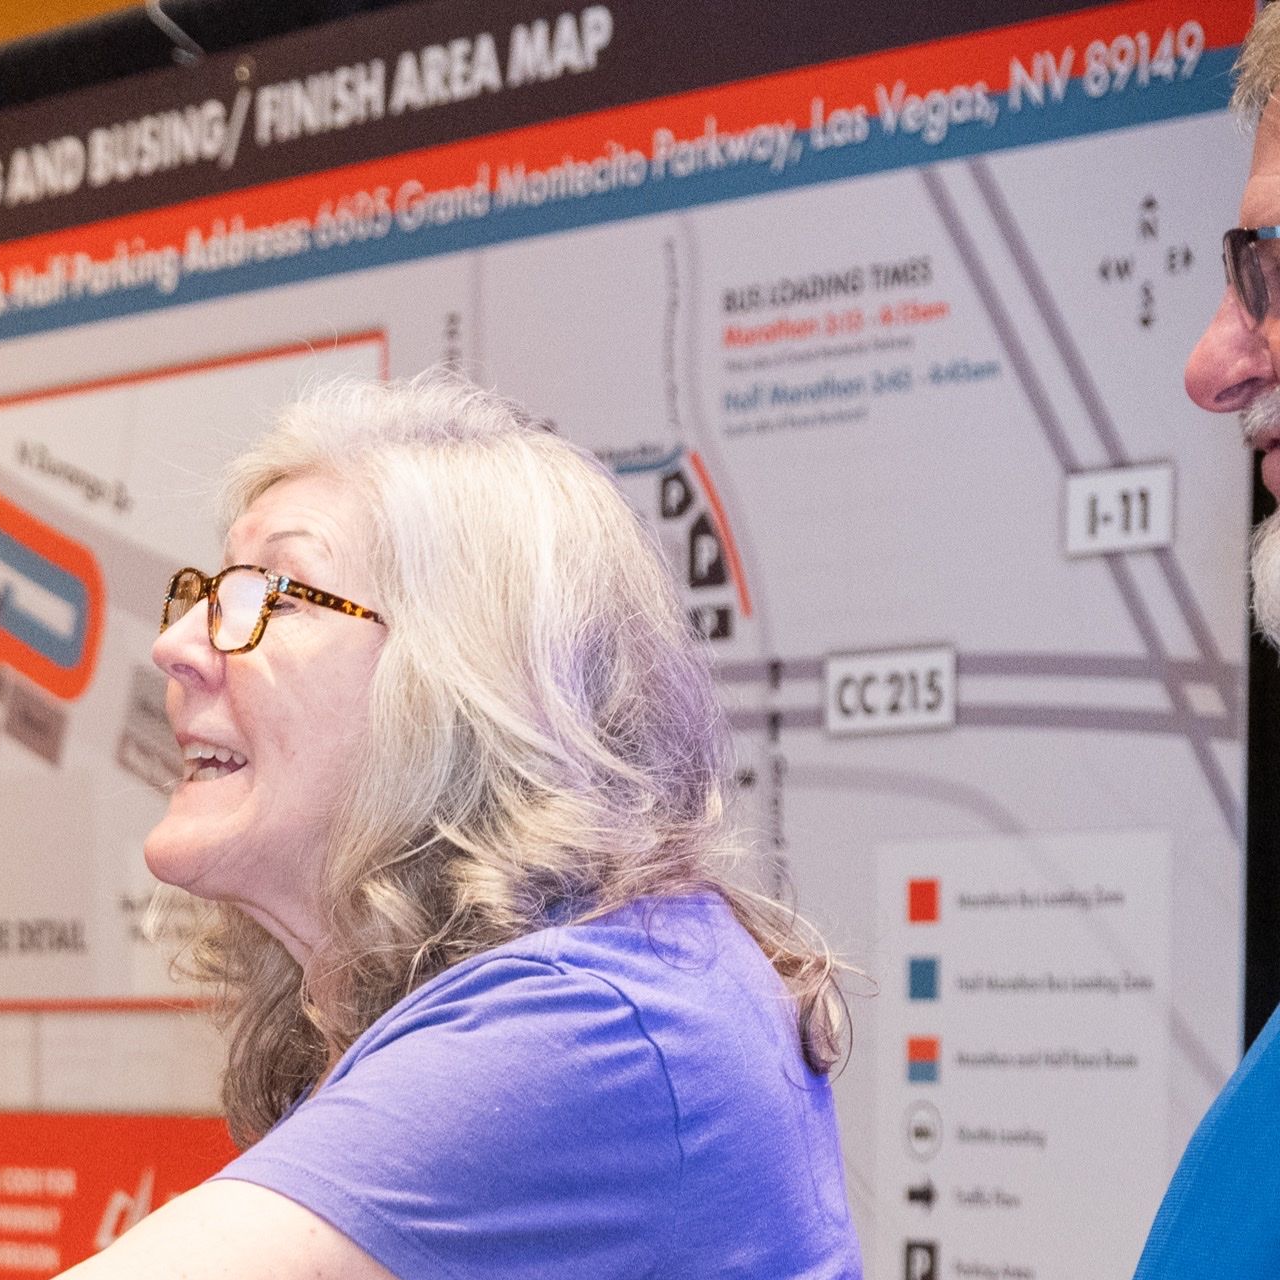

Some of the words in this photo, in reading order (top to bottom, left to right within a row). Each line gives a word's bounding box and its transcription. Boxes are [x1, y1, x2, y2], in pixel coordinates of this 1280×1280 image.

[6, 136, 85, 206] AND
[255, 58, 386, 147] FINISH
[389, 33, 502, 115] AREA
[505, 5, 613, 88] MAP
[9, 253, 68, 308] Half
[71, 236, 181, 295] Parking
[396, 162, 491, 233] Grand
[496, 140, 648, 208] Montecito
[652, 115, 801, 178] Parkway,
[810, 95, 869, 149] Las
[876, 80, 1000, 144] Vegas,
[1008, 46, 1075, 110] NV
[1083, 20, 1206, 100] 89149
[767, 267, 864, 310] LOADING
[868, 255, 934, 292] TIMES
[723, 317, 817, 348] Marathon
[722, 380, 762, 412] Half
[768, 371, 865, 407] Marathon
[1085, 489, 1153, 538] I-11
[838, 675, 883, 717] CC
[886, 669, 943, 714] 215
[17, 916, 88, 956] DETAIL
